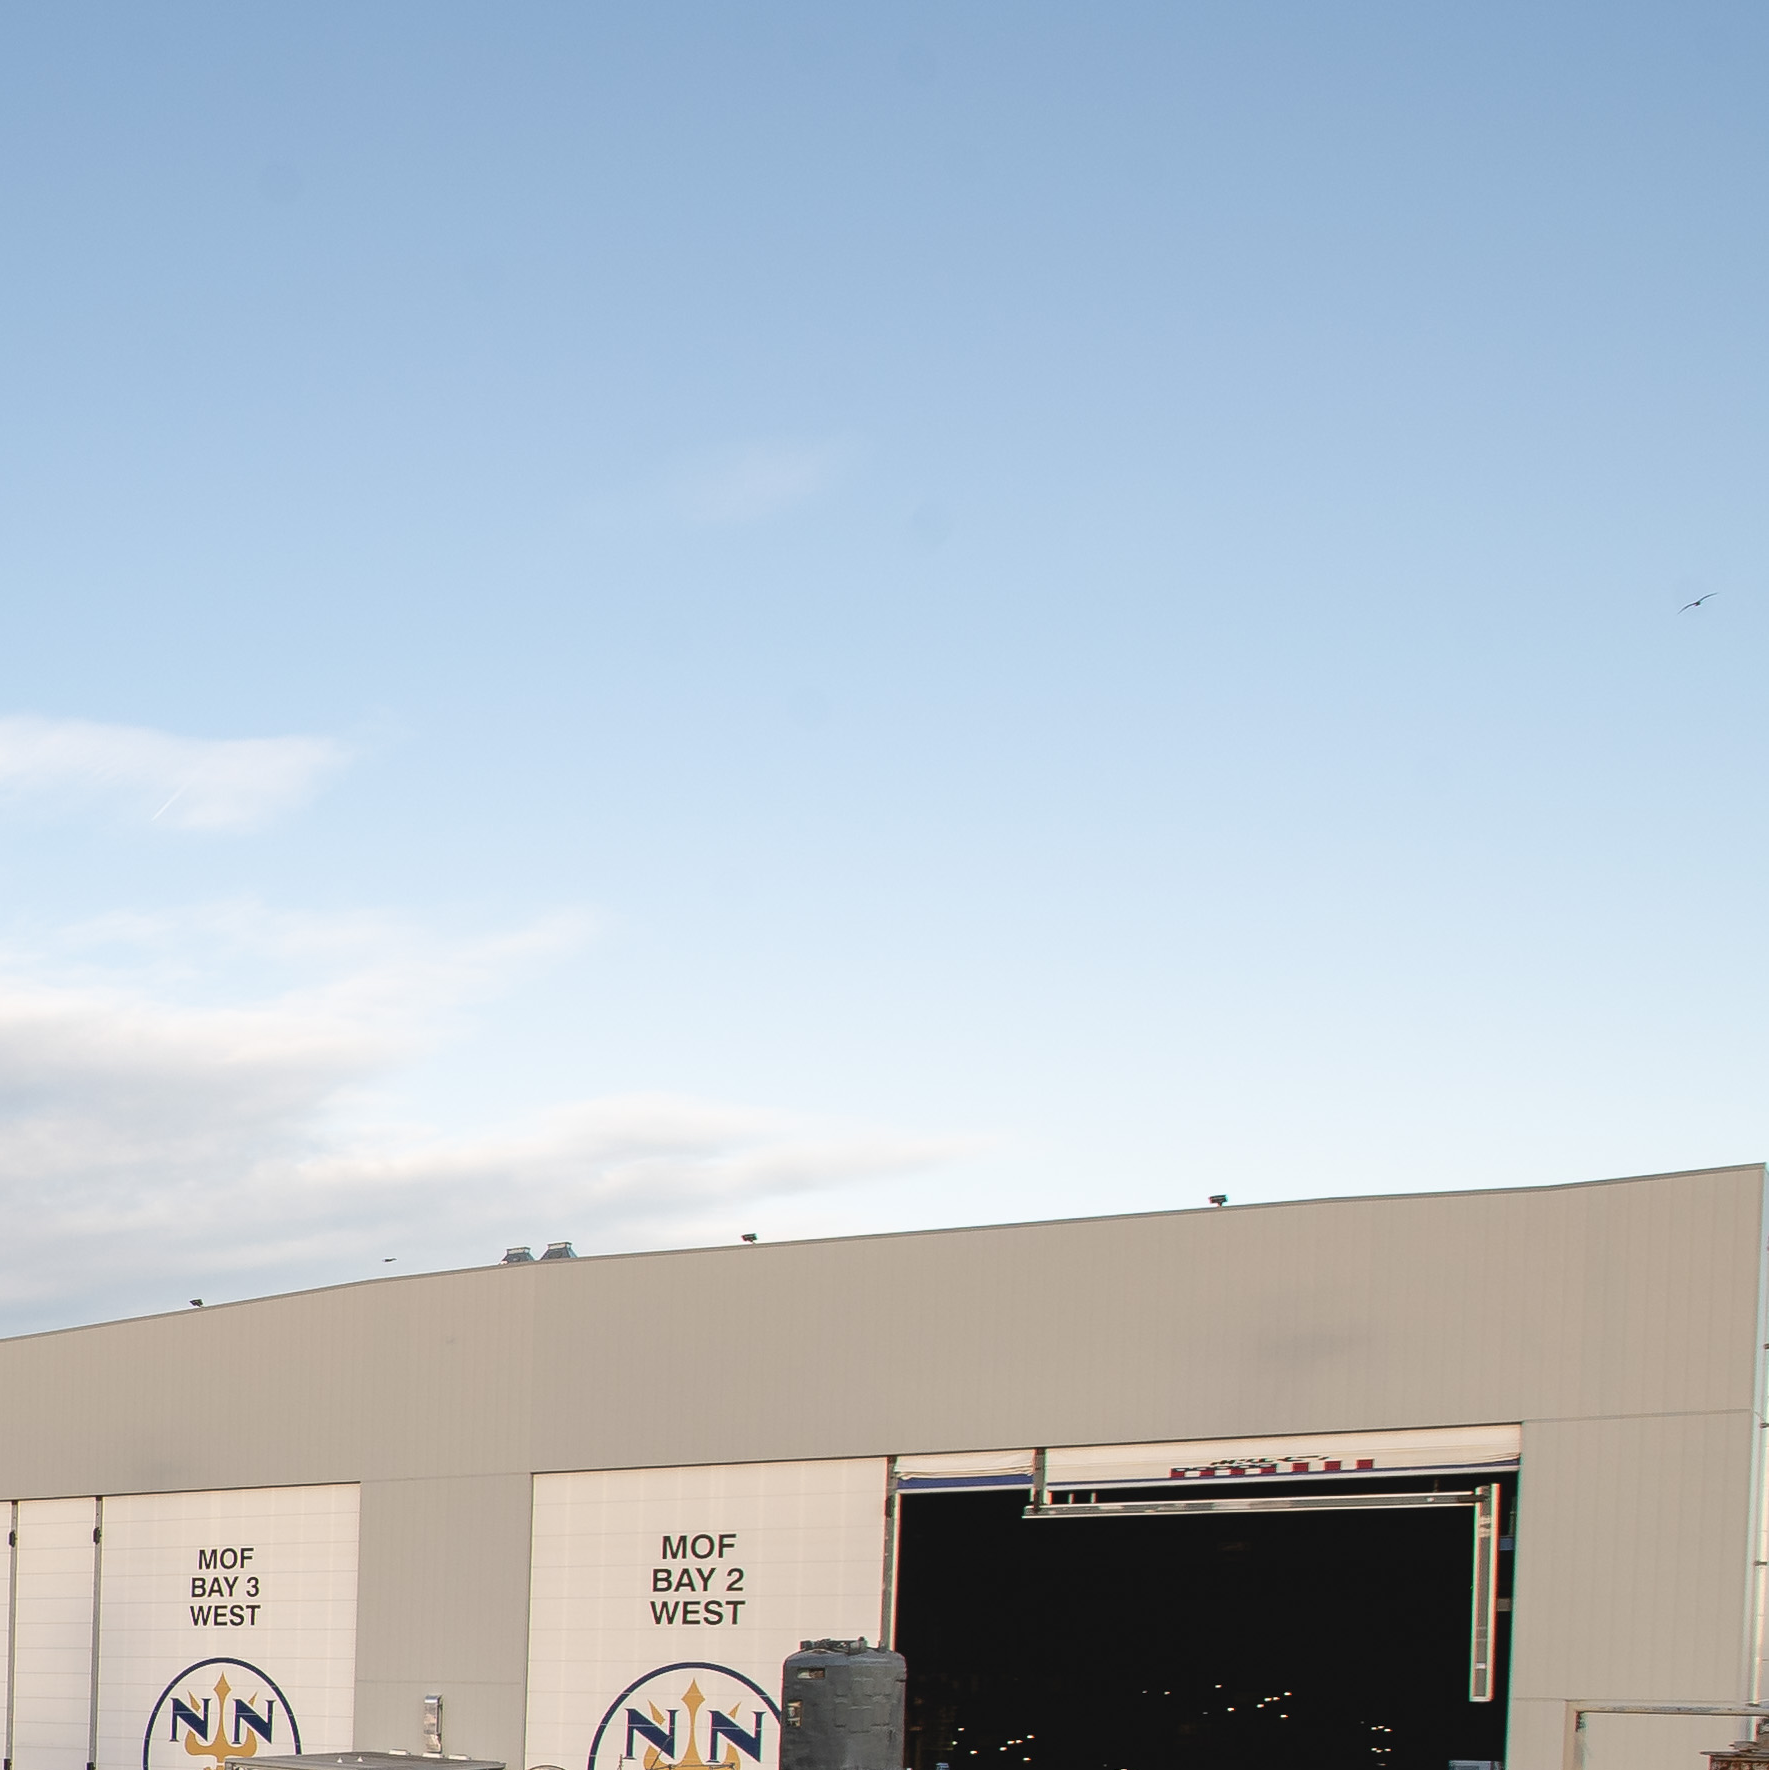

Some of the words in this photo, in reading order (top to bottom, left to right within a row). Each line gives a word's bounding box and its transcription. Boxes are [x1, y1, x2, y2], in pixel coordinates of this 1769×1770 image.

[198, 1547, 255, 1570] MOF
[661, 1533, 737, 1560] MOF
[191, 1575, 239, 1598] BAY
[246, 1576, 260, 1598] 3
[652, 1567, 717, 1593] BAY
[725, 1567, 744, 1592] 2
[189, 1604, 262, 1627] WEST
[649, 1599, 746, 1625] WEST
